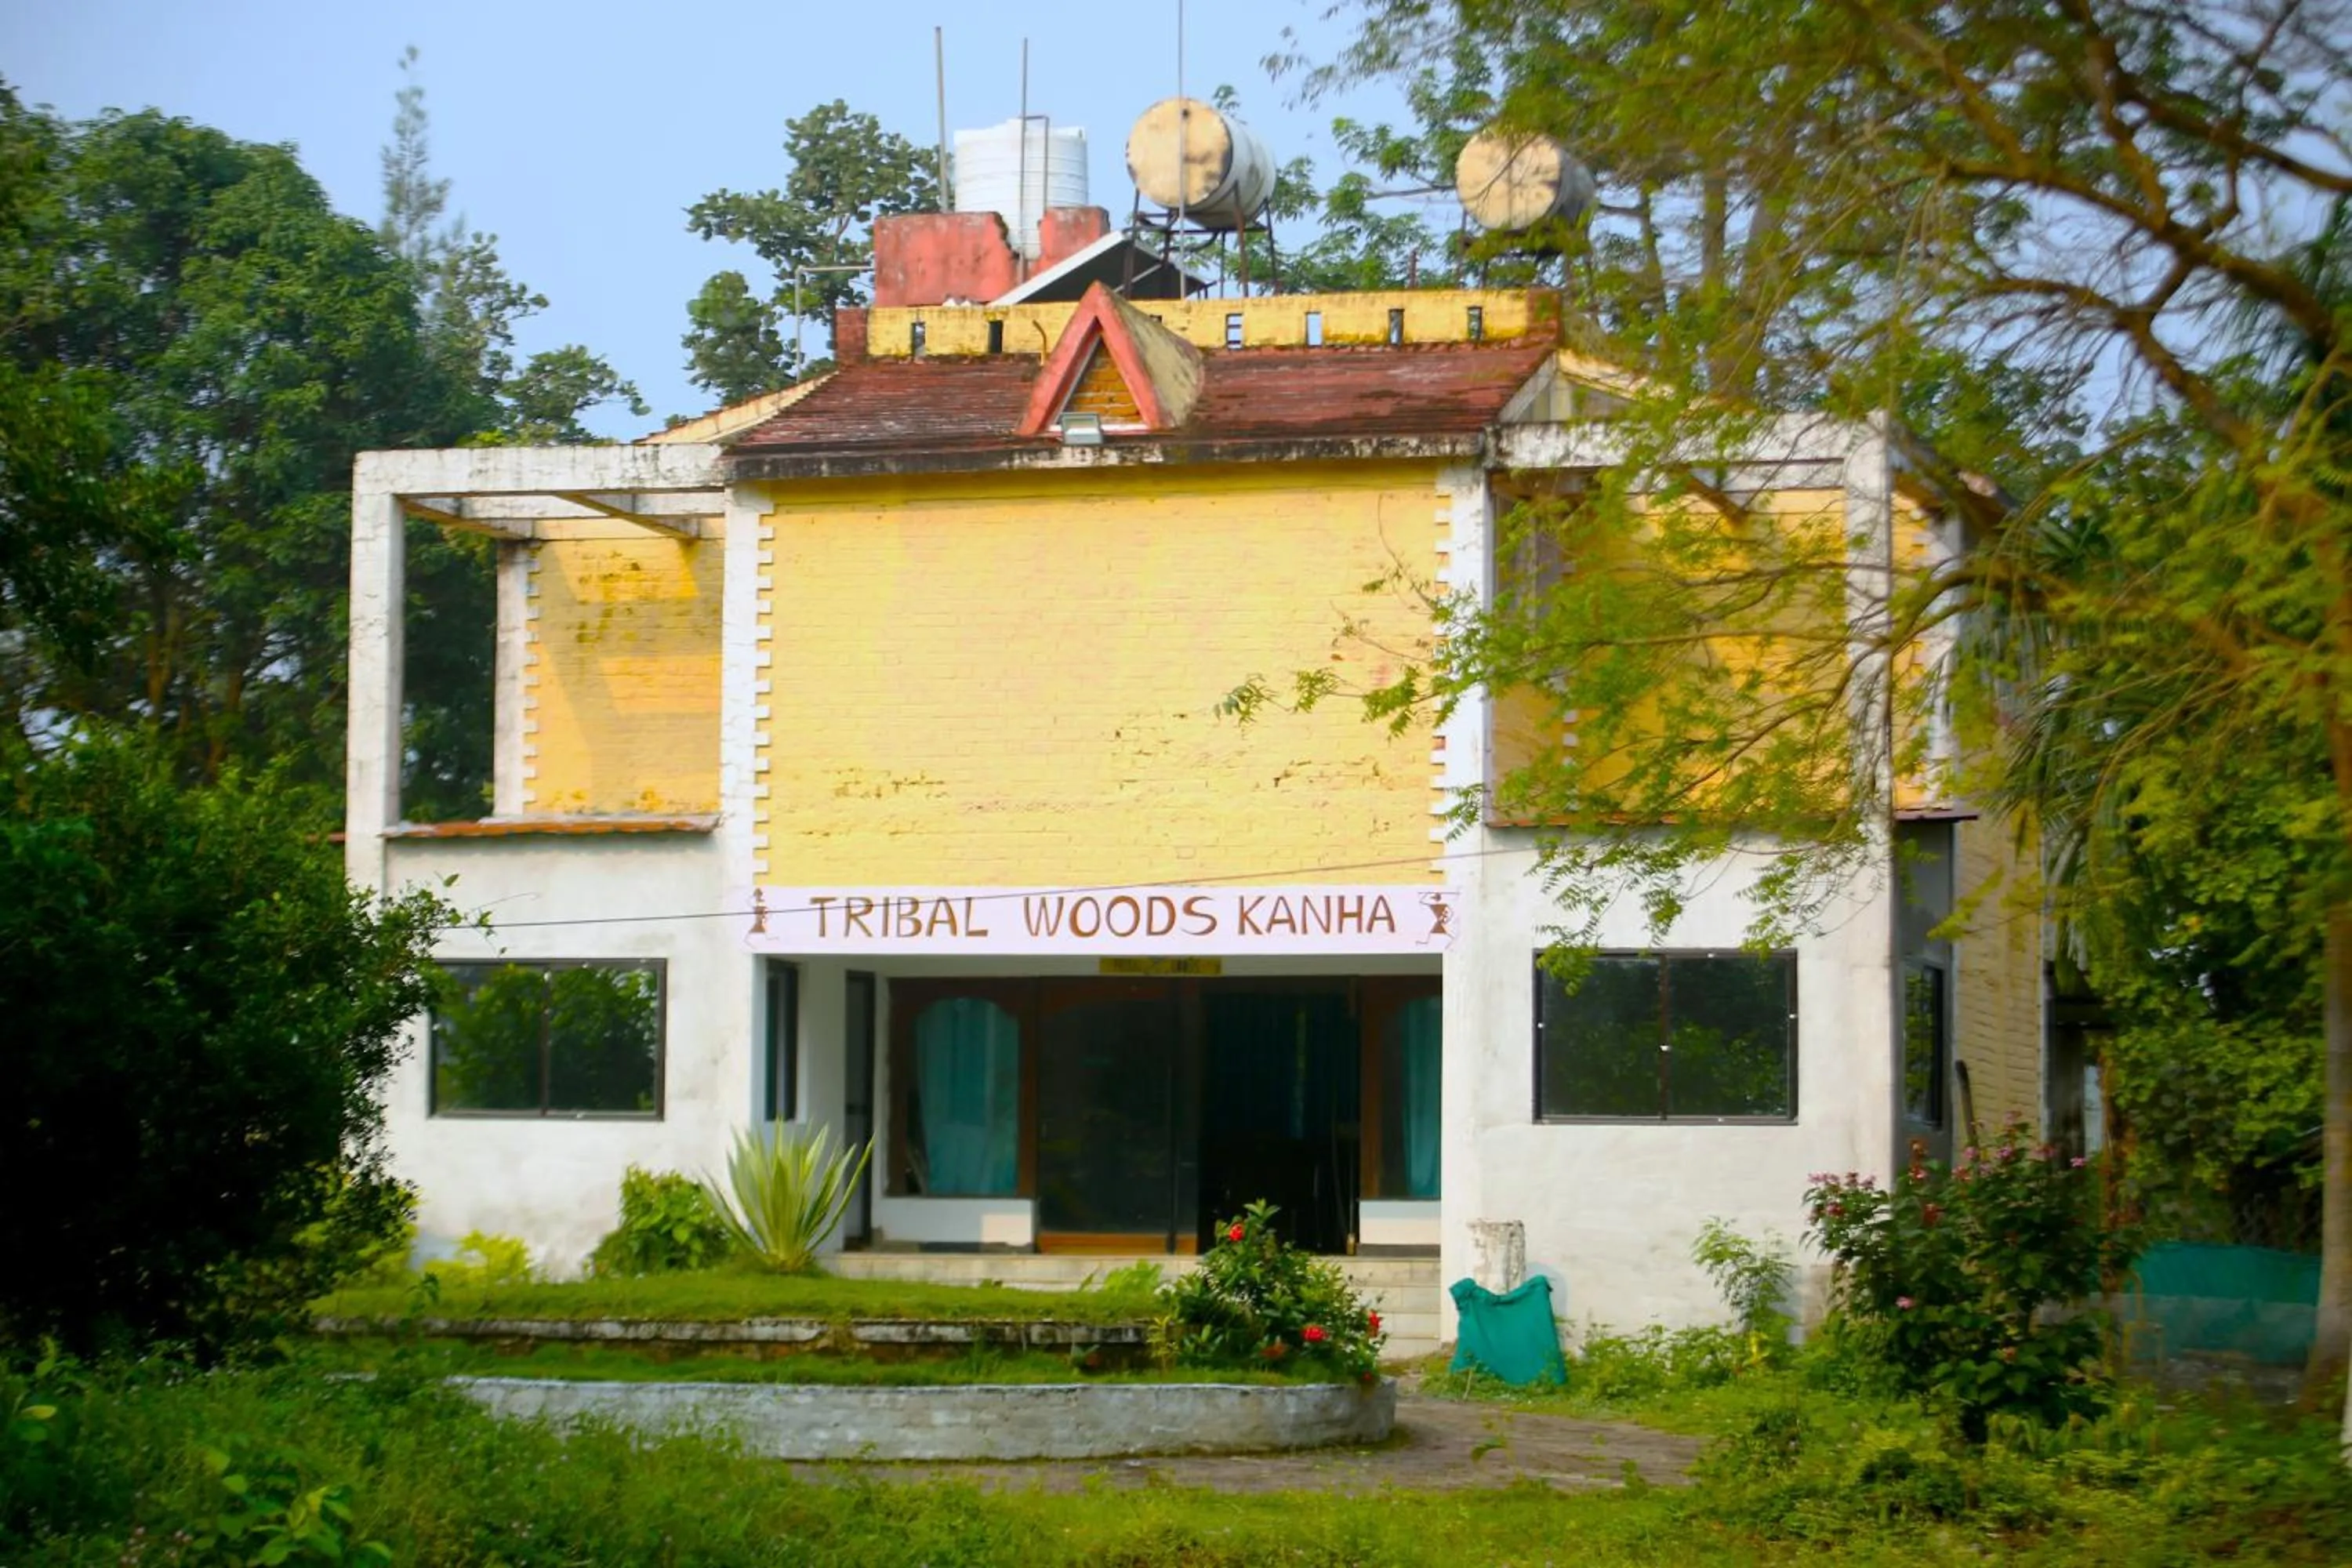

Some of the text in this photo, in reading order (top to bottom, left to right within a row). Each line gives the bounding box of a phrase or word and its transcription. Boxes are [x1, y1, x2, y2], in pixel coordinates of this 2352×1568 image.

[810, 894, 1396, 938] TRIBAL WOODS KANHA
